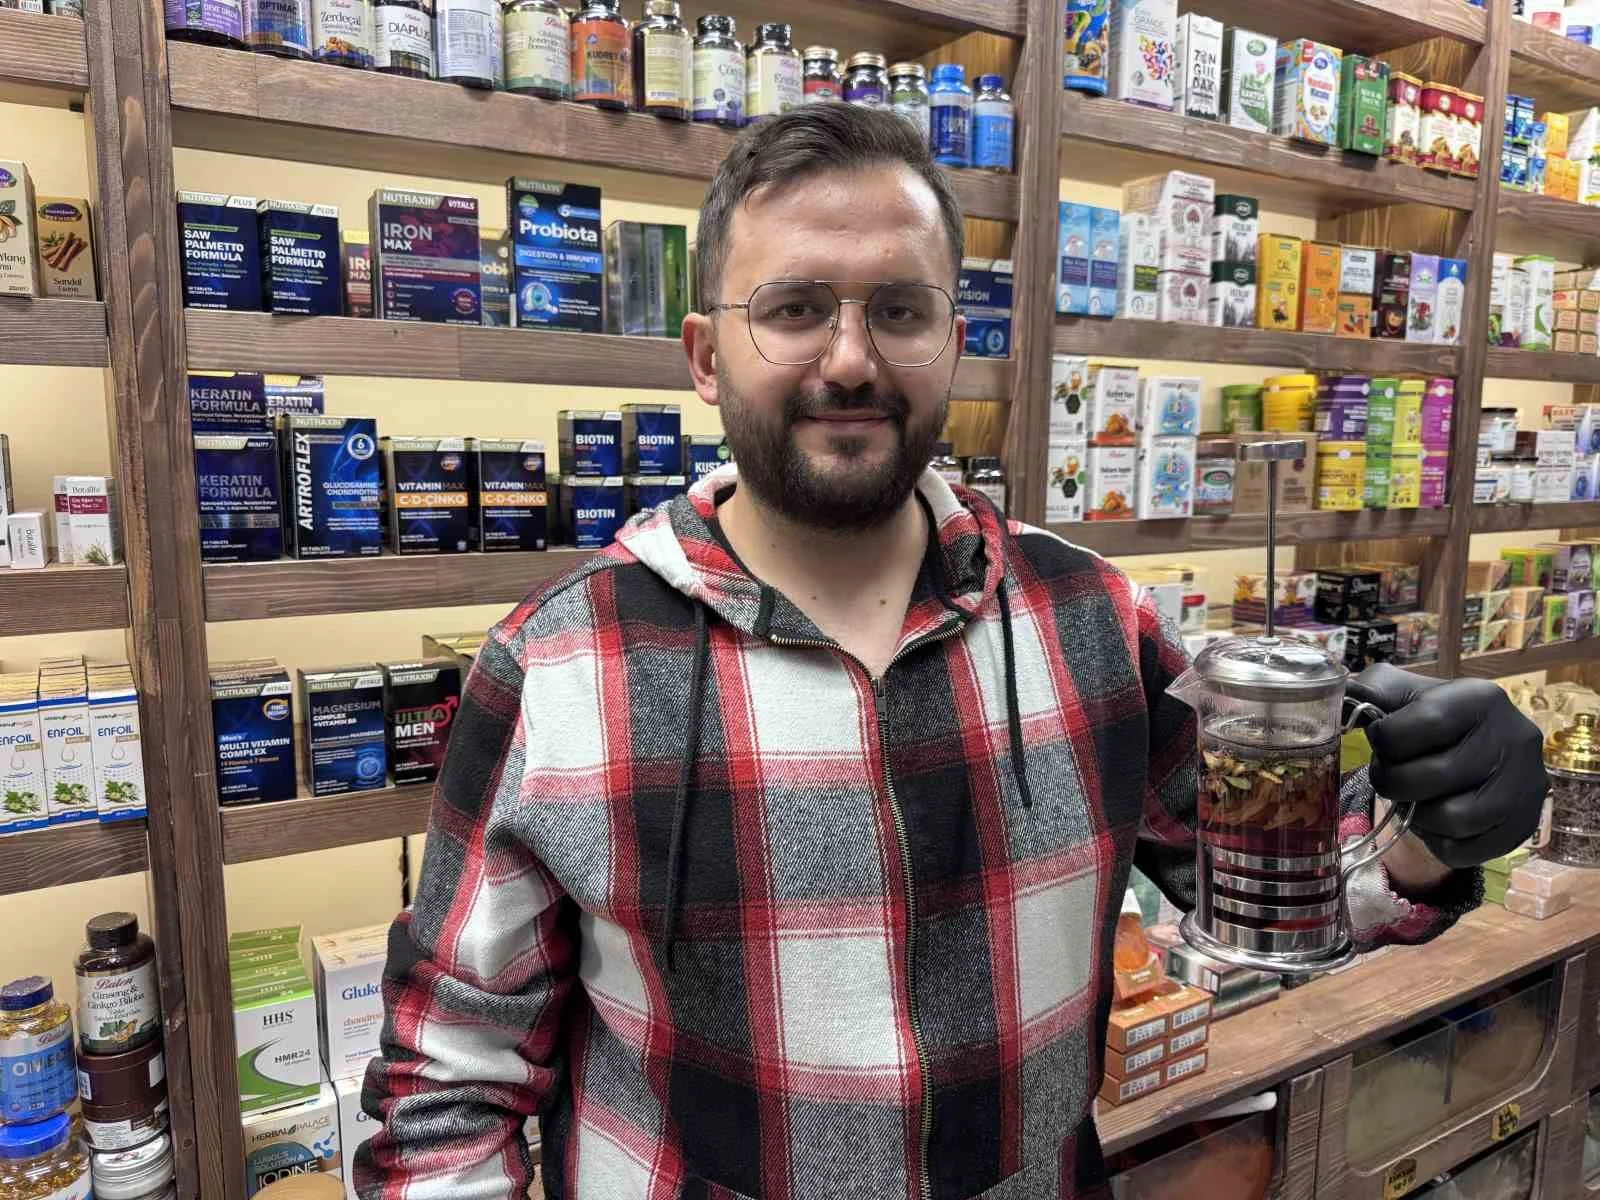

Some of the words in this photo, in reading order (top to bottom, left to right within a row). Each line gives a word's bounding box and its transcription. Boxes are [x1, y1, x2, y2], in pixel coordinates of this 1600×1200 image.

[383, 192, 435, 205] NUTRAXIN
[184, 229, 211, 240] SAW
[383, 222, 433, 241] IRON
[519, 219, 598, 243] Probiota
[184, 239, 245, 252] PALMETTO
[271, 236, 296, 247] SAW
[383, 238, 413, 251] MAX
[185, 249, 243, 262] FORMULA
[271, 245, 327, 259] PALMETTO
[271, 254, 324, 269] FORMULA
[191, 388, 252, 400] KERATIN
[191, 399, 262, 413] FORMULA
[576, 434, 615, 445] BIOTIN
[638, 435, 675, 446] BIOTIN
[199, 474, 262, 487] KERATIN
[297, 432, 314, 531] ARTROFLEX
[398, 482, 442, 491] VITAMIN
[484, 481, 524, 491] VITAMIN
[199, 486, 272, 498] FORMULA
[577, 509, 616, 519] BIOTIN
[393, 672, 434, 684] NUTRAXIN
[215, 686, 258, 698] NUTRAXIN
[312, 700, 382, 714] MAGNESIUM
[313, 712, 346, 722] COMPLEX
[395, 722, 436, 739] MEN
[219, 742, 250, 752] MULTI
[250, 737, 291, 749] VITAMIN
[219, 748, 267, 760] COMPLEX
[263, 1010, 294, 1027] HHS
